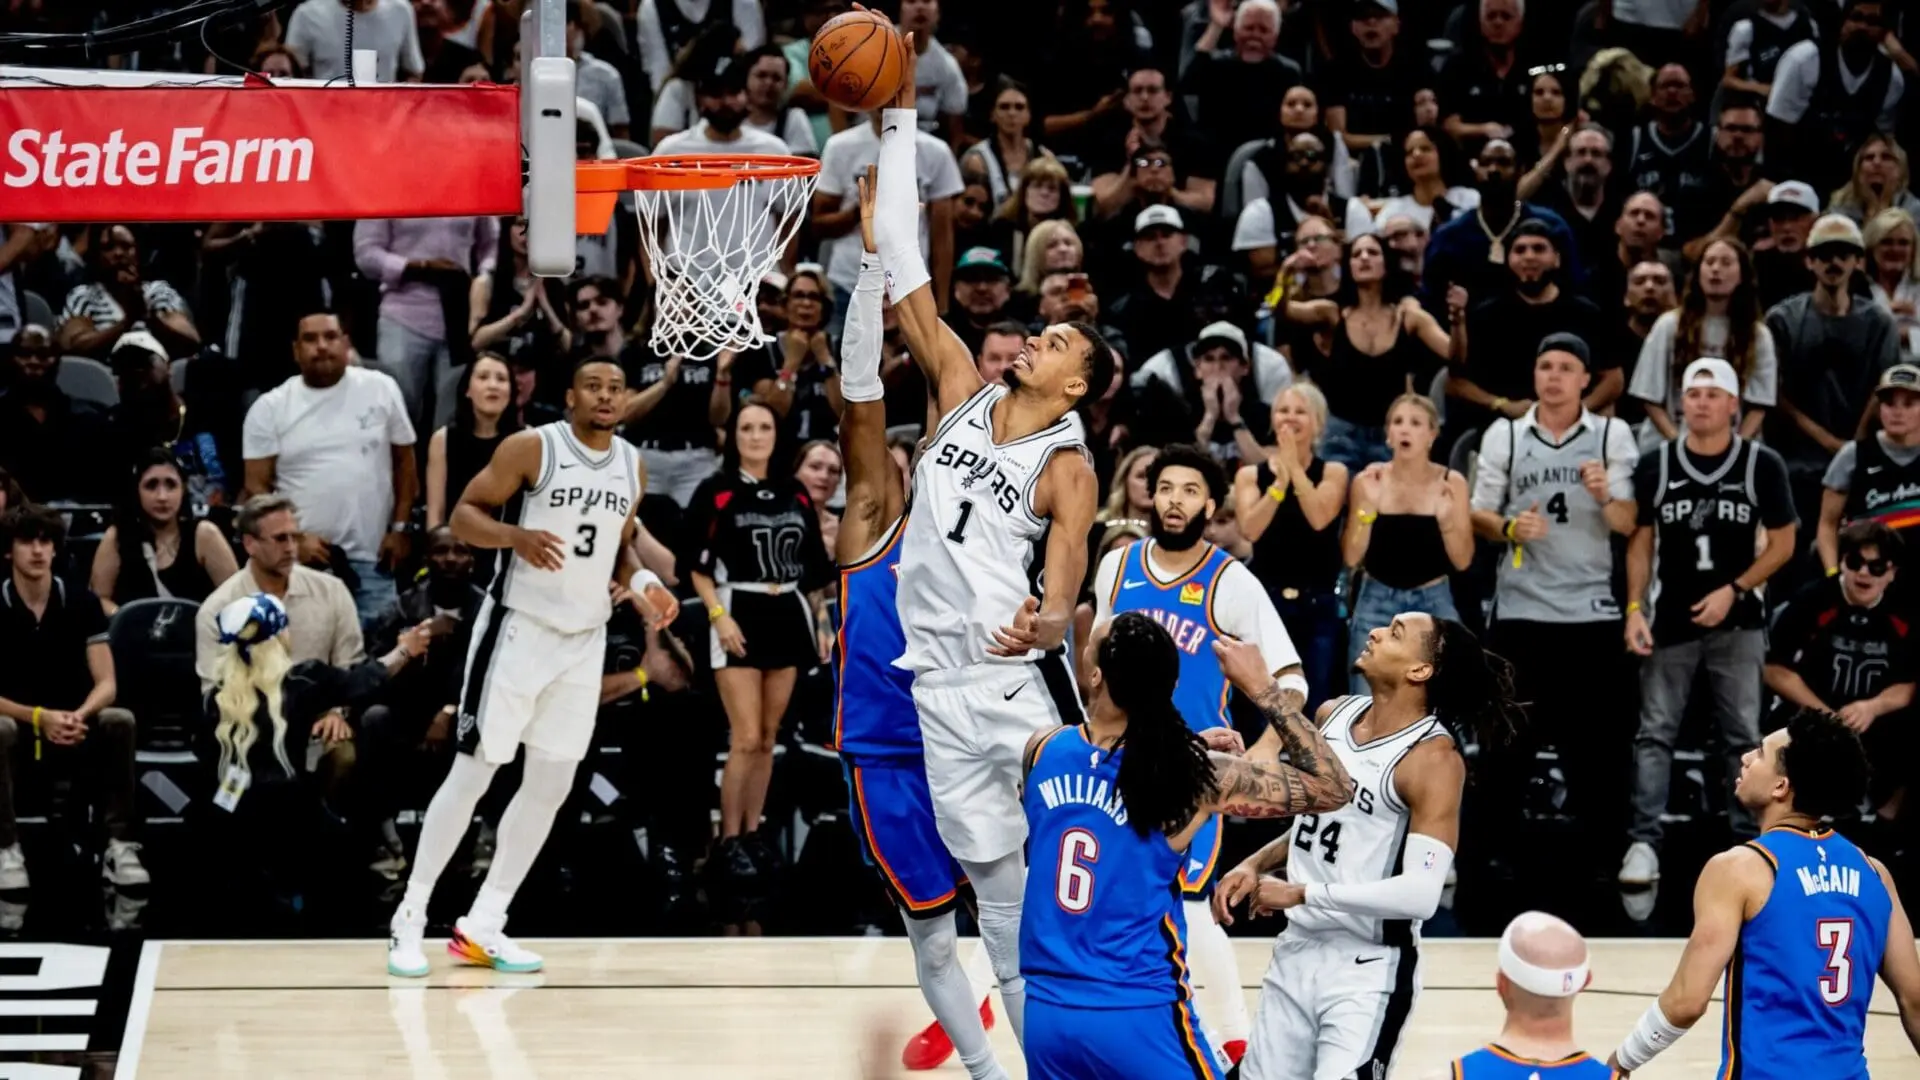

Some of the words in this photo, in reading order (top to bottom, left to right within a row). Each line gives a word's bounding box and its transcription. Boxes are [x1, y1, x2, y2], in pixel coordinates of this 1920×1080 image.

[936, 443, 1020, 514] SPURS
[1516, 470, 1539, 495] SAN
[1542, 466, 1582, 486] ANTO
[549, 487, 629, 517] SPURS
[1547, 492, 1569, 524] 4
[1661, 498, 1751, 529] SPURS
[573, 523, 598, 558] 3
[946, 500, 973, 545] 1
[1696, 535, 1714, 571] 1
[1138, 608, 1207, 655] NDER
[1295, 813, 1342, 864] 24
[1055, 827, 1099, 915] 6
[1796, 864, 1861, 898] McCAIN
[1816, 917, 1853, 1007] 3
